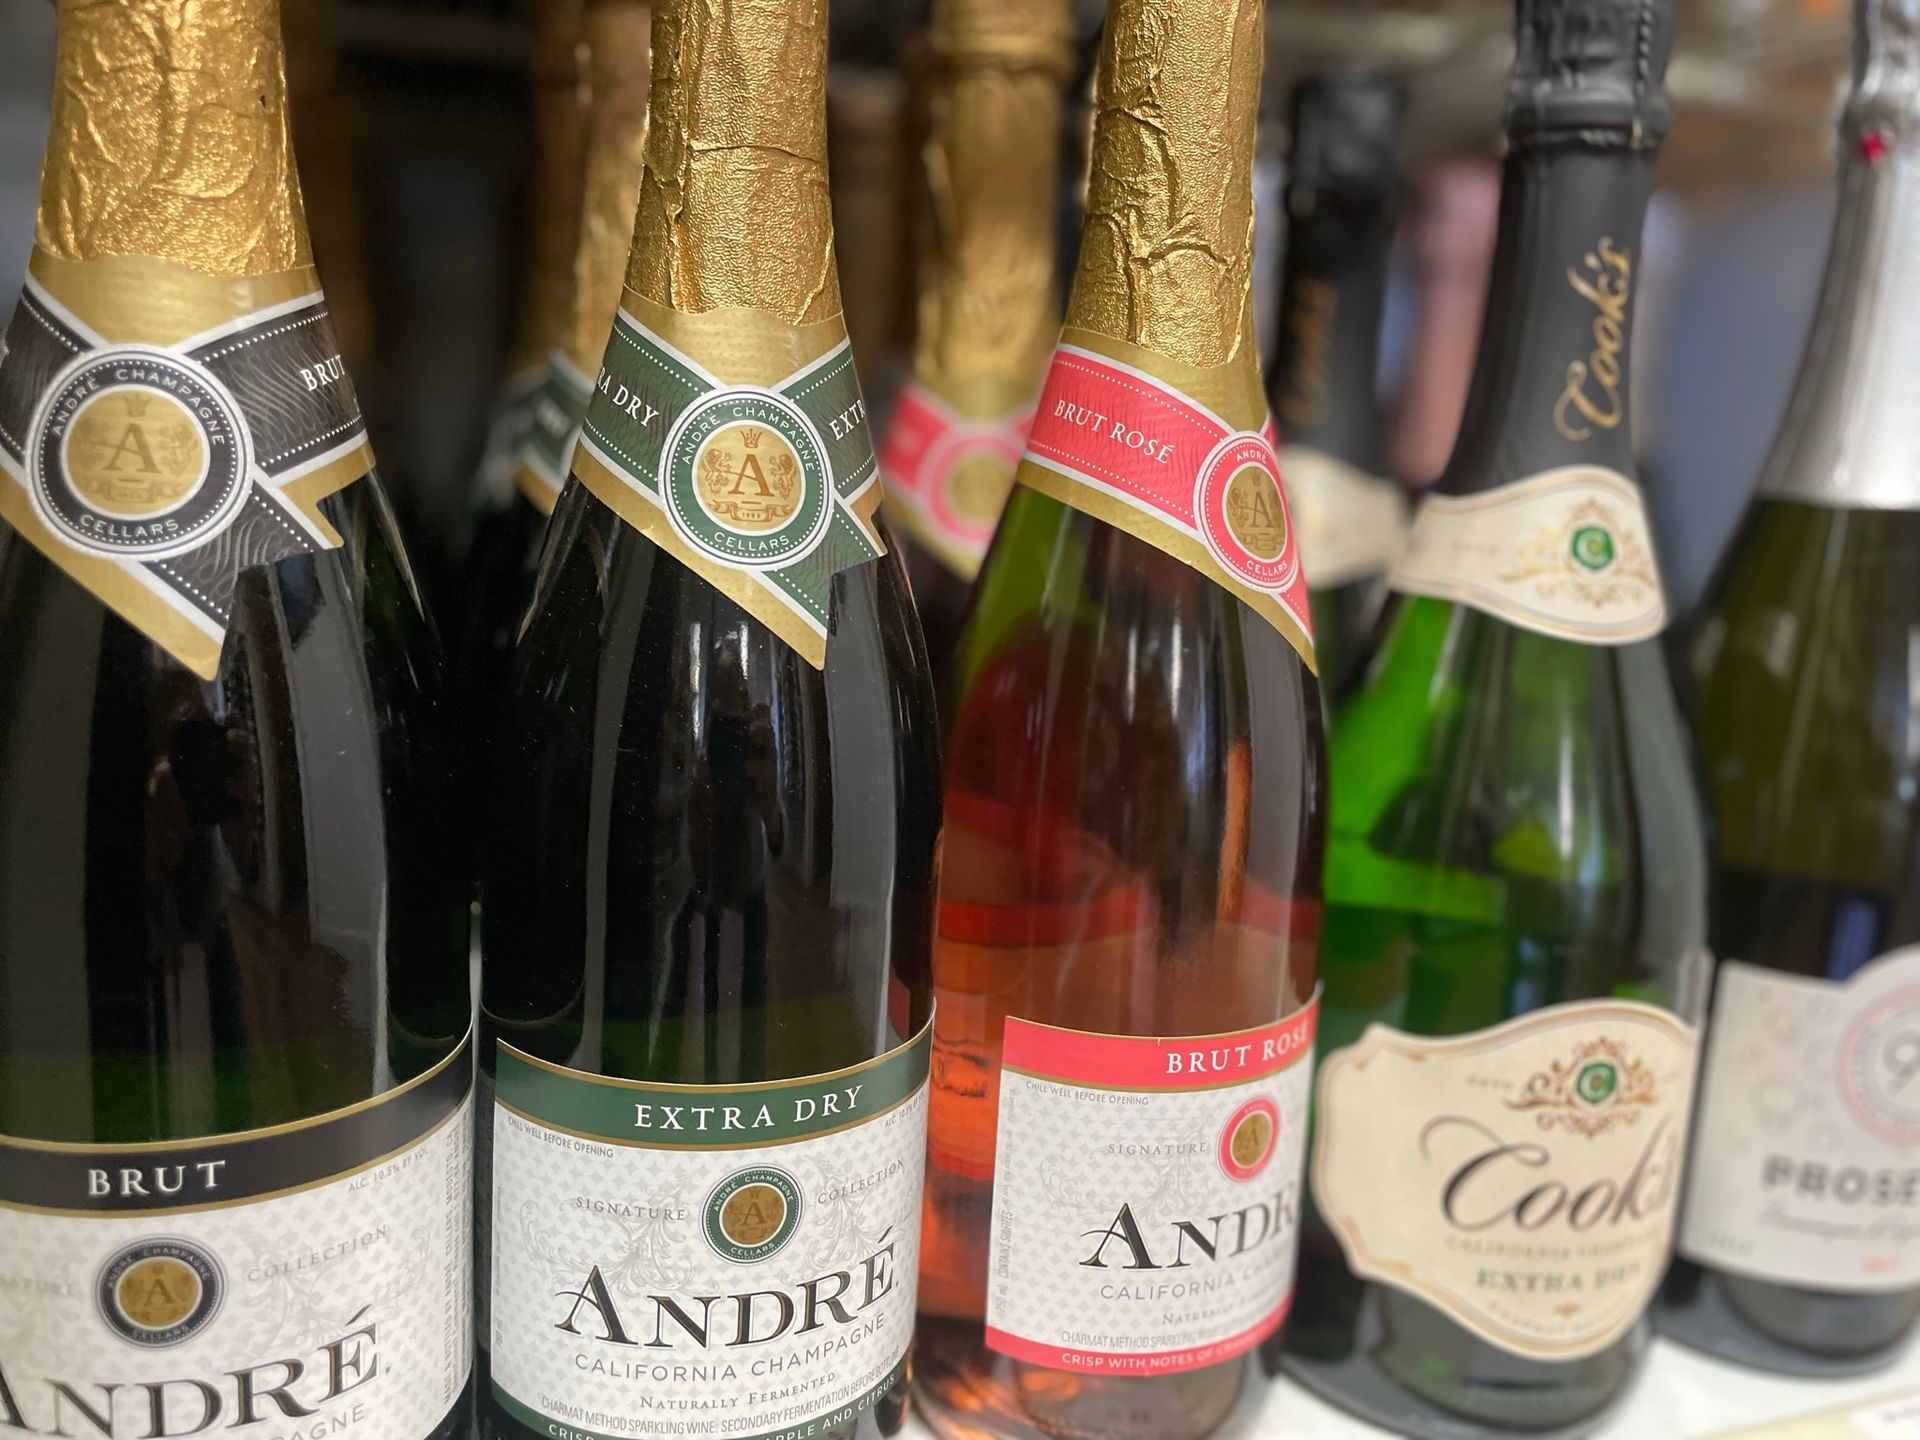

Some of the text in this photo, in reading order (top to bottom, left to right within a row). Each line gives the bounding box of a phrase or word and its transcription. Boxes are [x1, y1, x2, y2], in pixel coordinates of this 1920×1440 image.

[1553, 236, 1630, 441] Cook's
[114, 368, 225, 445] CHAMPAGNE
[613, 384, 659, 427] DRY
[732, 406, 815, 472] CHAMPAGNE
[1054, 399, 1175, 464] BRUT ROSÉ
[79, 513, 179, 538] CELLARS
[714, 531, 790, 551] CELLARS
[1246, 560, 1288, 577] CELLARS
[1165, 1044, 1252, 1074] BRUT
[633, 1085, 864, 1131] EXTRA DRY
[1026, 1080, 1150, 1106] CHILL WELL BEFORE OPENING
[507, 1115, 615, 1158] CHILL WELL BEFORE OPENING
[1107, 1142, 1206, 1156] SIGNATURE
[88, 1160, 227, 1197] BRUT
[744, 1174, 794, 1202] CHAMPAGNE
[817, 1157, 904, 1205] COLLECTION
[576, 1196, 687, 1221] SIGNATURE
[247, 1223, 388, 1283] COLLECTION
[730, 1242, 775, 1256] CELLARS
[554, 1225, 895, 1348] ANDRÉ
[1100, 1273, 1236, 1300] CALIFORNIA
[575, 1312, 885, 1382] CALIFORNIA CHAMPAGNE
[1061, 1330, 1109, 1348] CHARMAT
[1109, 1335, 1150, 1349] METHOD
[1062, 1352, 1104, 1366] CRISP
[1108, 1357, 1146, 1369] WITH
[1151, 1353, 1195, 1368] NOTES
[640, 1372, 836, 1410] NATURALLY FERMENTED
[822, 1408, 853, 1430] AND
[858, 1372, 896, 1411] CITRUS
[542, 1396, 585, 1421] CHARMAT
[585, 1411, 627, 1431] METHOD
[628, 1420, 685, 1436] SPARKLING
[721, 1410, 783, 1433] SECONDARY
[784, 1386, 850, 1421] FERMENTATION
